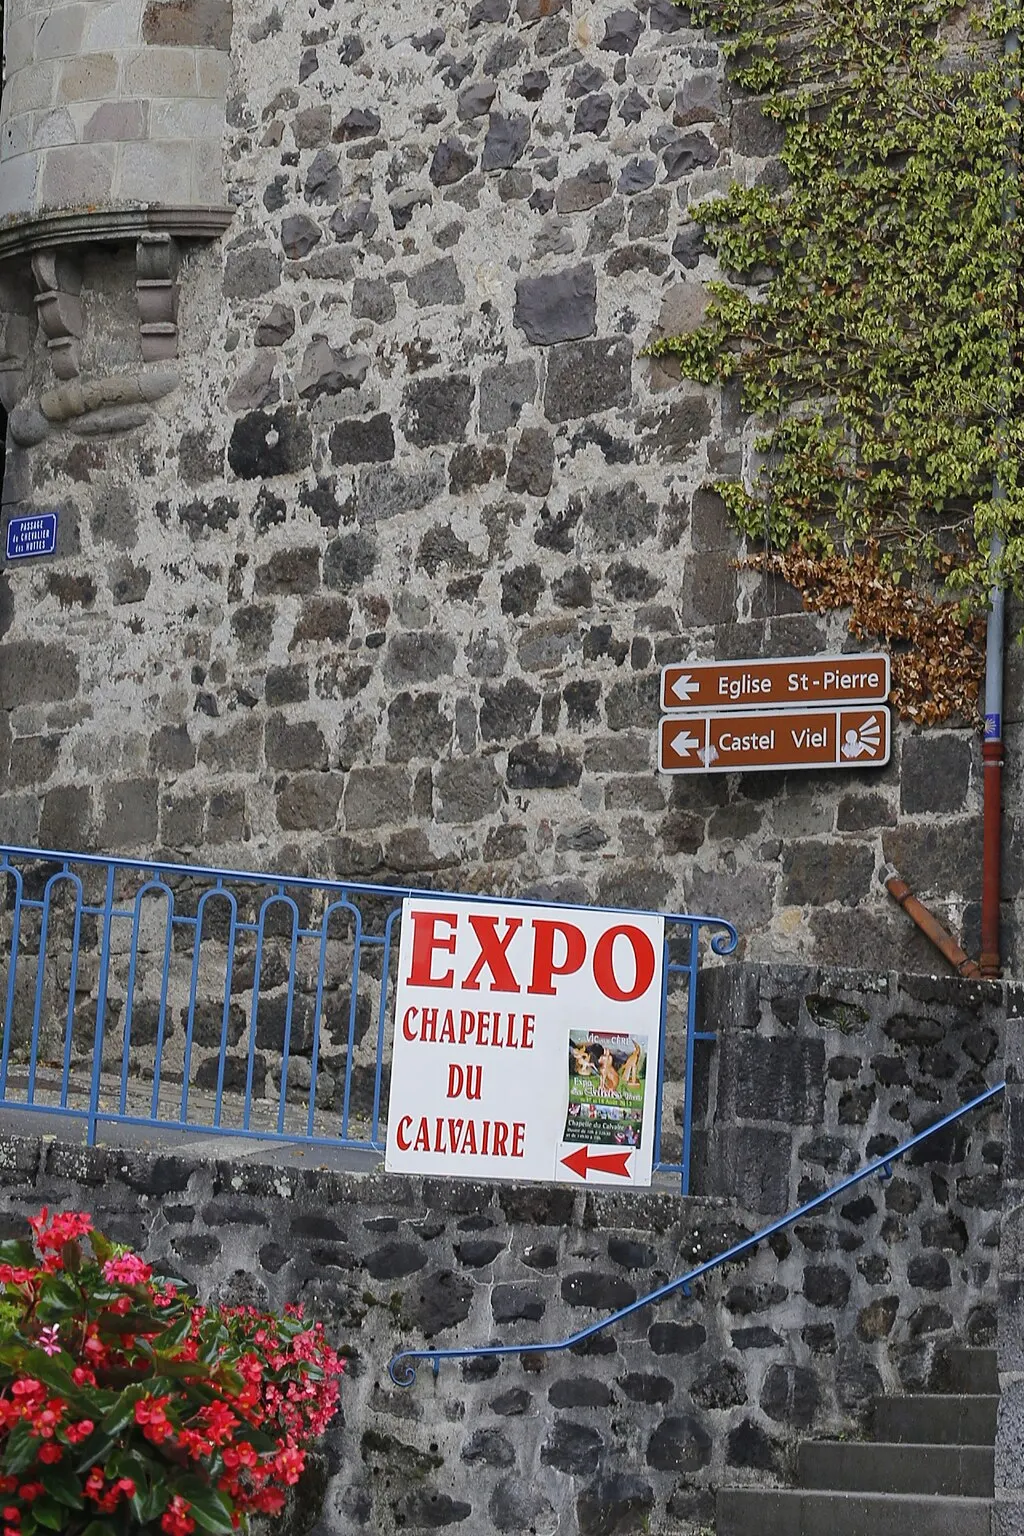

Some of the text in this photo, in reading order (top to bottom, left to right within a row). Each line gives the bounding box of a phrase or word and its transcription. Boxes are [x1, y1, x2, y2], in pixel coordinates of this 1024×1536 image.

[20, 520, 43, 532] PASSAGE
[21, 529, 50, 542] CHEVALIER
[718, 674, 772, 699] Eglise
[718, 727, 828, 751] Castel Viel
[405, 911, 656, 1003] EXPO
[402, 1006, 536, 1050] CHAPELLE
[446, 1064, 482, 1101] DU
[396, 1114, 526, 1158] CALVAIRE
